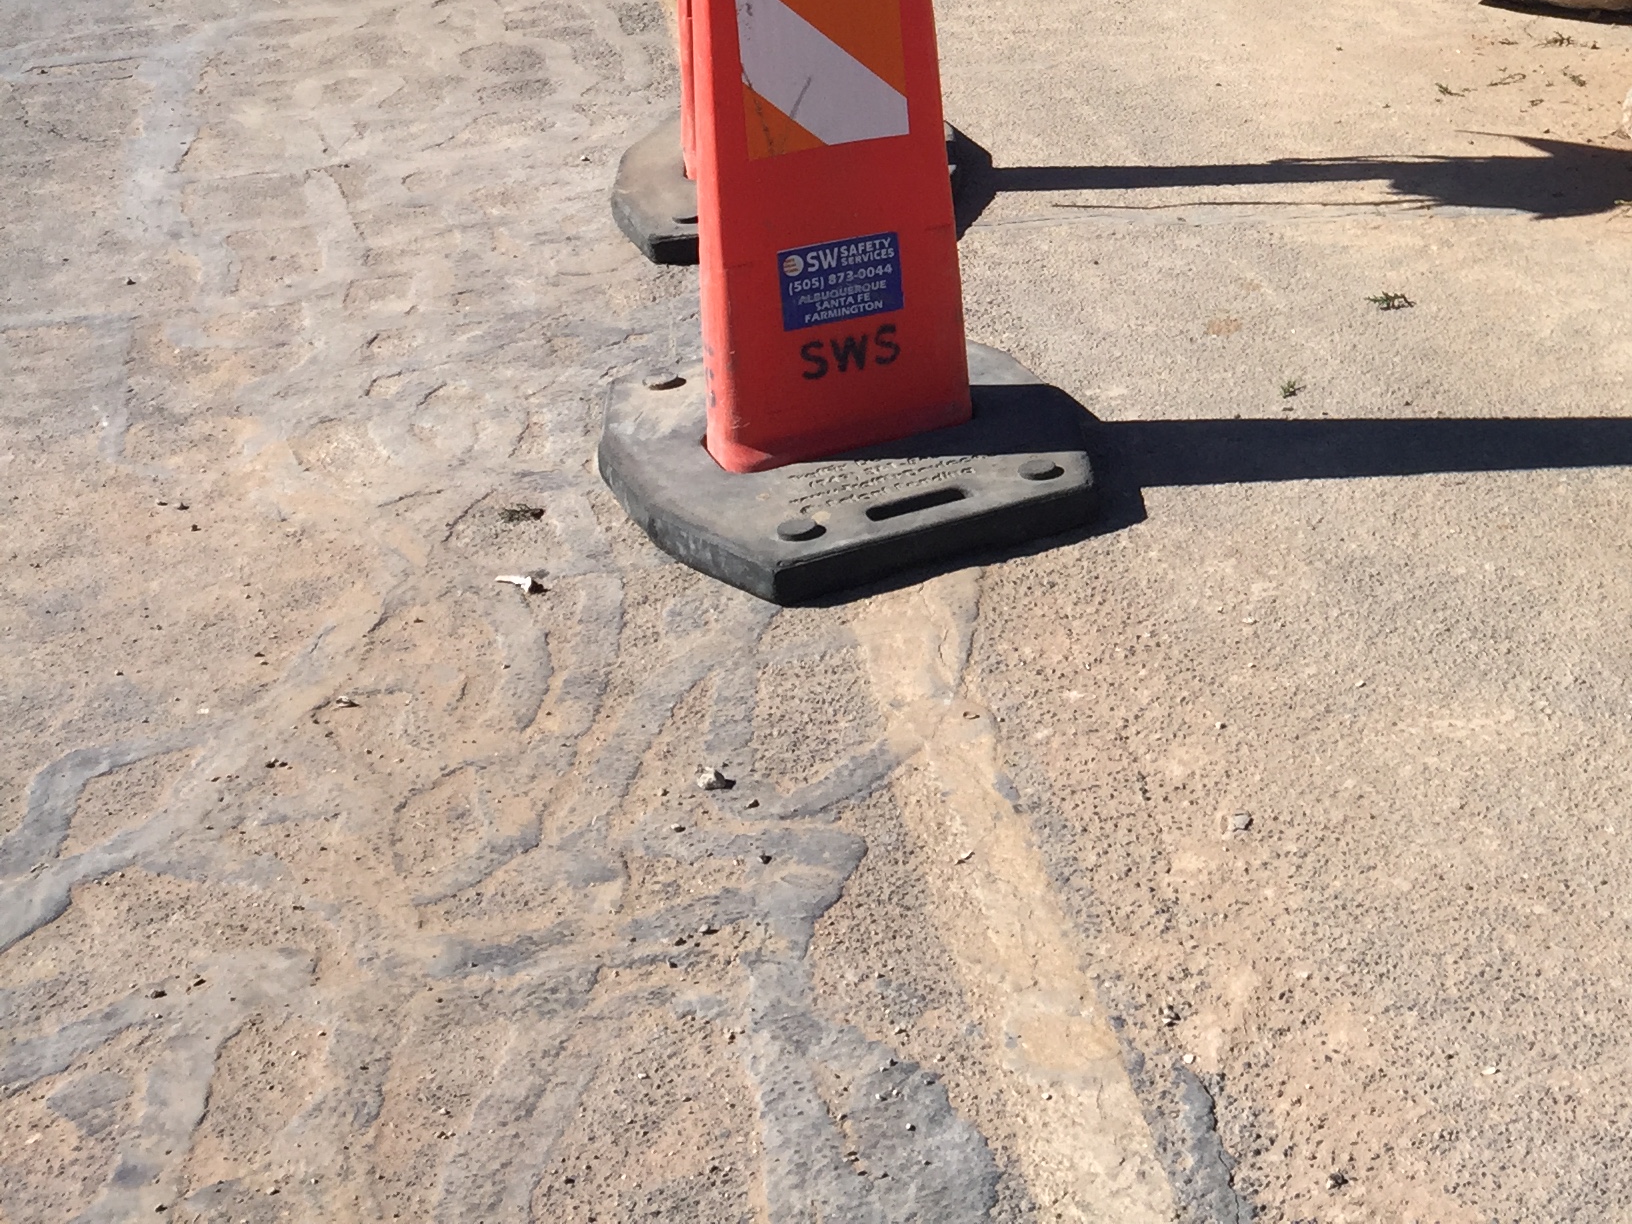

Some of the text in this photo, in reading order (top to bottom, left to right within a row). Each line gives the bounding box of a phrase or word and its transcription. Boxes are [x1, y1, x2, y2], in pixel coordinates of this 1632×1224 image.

[806, 247, 839, 273] SW
[840, 237, 891, 257] SAFETY
[841, 247, 895, 266] SERVICES
[788, 263, 893, 296] (505) 873-0044
[798, 279, 887, 306] ALBUQUERQUE
[804, 299, 884, 324] FARMINGTON
[815, 292, 871, 312] SANTA FE
[800, 323, 901, 380] SWS
